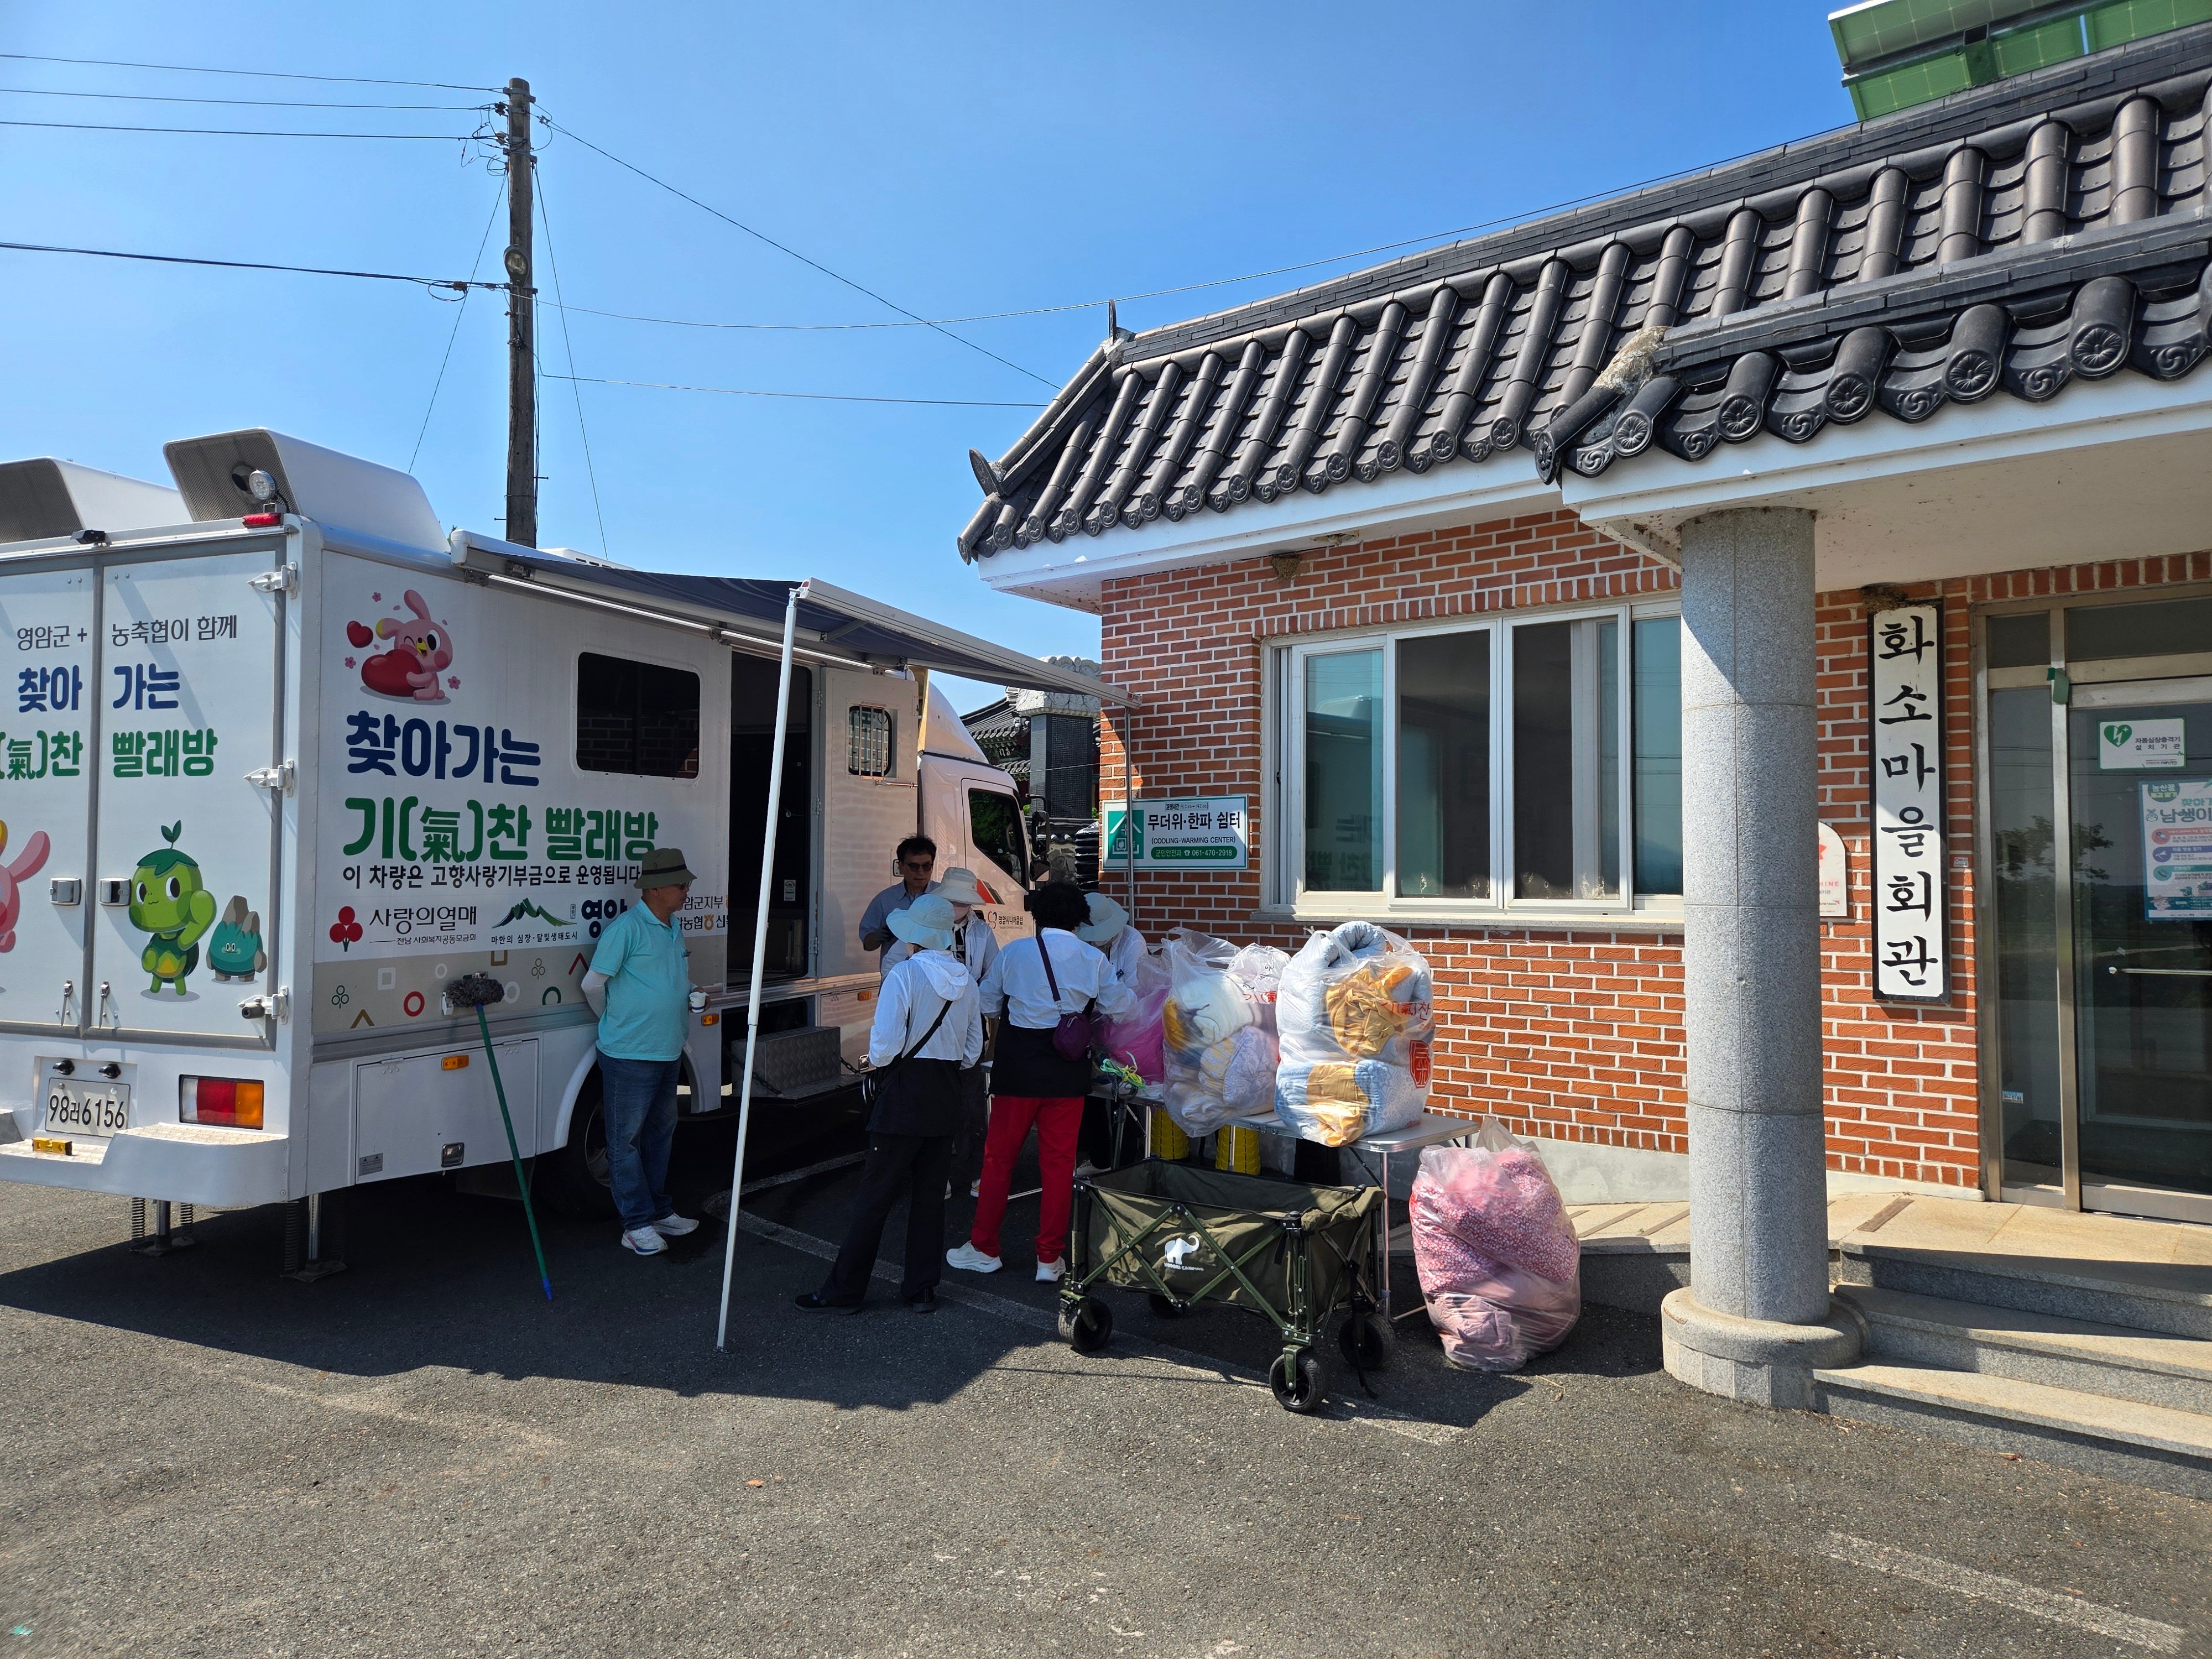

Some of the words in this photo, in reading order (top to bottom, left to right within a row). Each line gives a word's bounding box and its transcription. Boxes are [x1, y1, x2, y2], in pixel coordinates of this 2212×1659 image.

[17, 625, 70, 650] 영암군
[112, 619, 190, 646] 농축협이
[197, 615, 237, 640] 함께
[18, 665, 82, 712] 찾아
[113, 663, 180, 710] 가는
[113, 728, 218, 778] 빨래방
[346, 710, 541, 786] 찾아가는
[1879, 615, 1938, 985] 화소마을회관
[343, 796, 532, 863] 기(氣)찬
[545, 807, 659, 861] 빨래방
[1147, 812, 1212, 830] 무더위·한파
[1217, 811, 1240, 829] 쉼터
[343, 866, 361, 889] 이
[369, 864, 424, 889] 차량은
[430, 865, 571, 886] 고향사랑기부금으로
[576, 864, 641, 885] 운영됩니다
[369, 906, 477, 934] 사랑의열매
[397, 937, 411, 945] 전남
[413, 933, 476, 944] 사회복지공동모금회
[491, 935, 513, 945] 마한의
[50, 1095, 124, 1129] 98러6156
